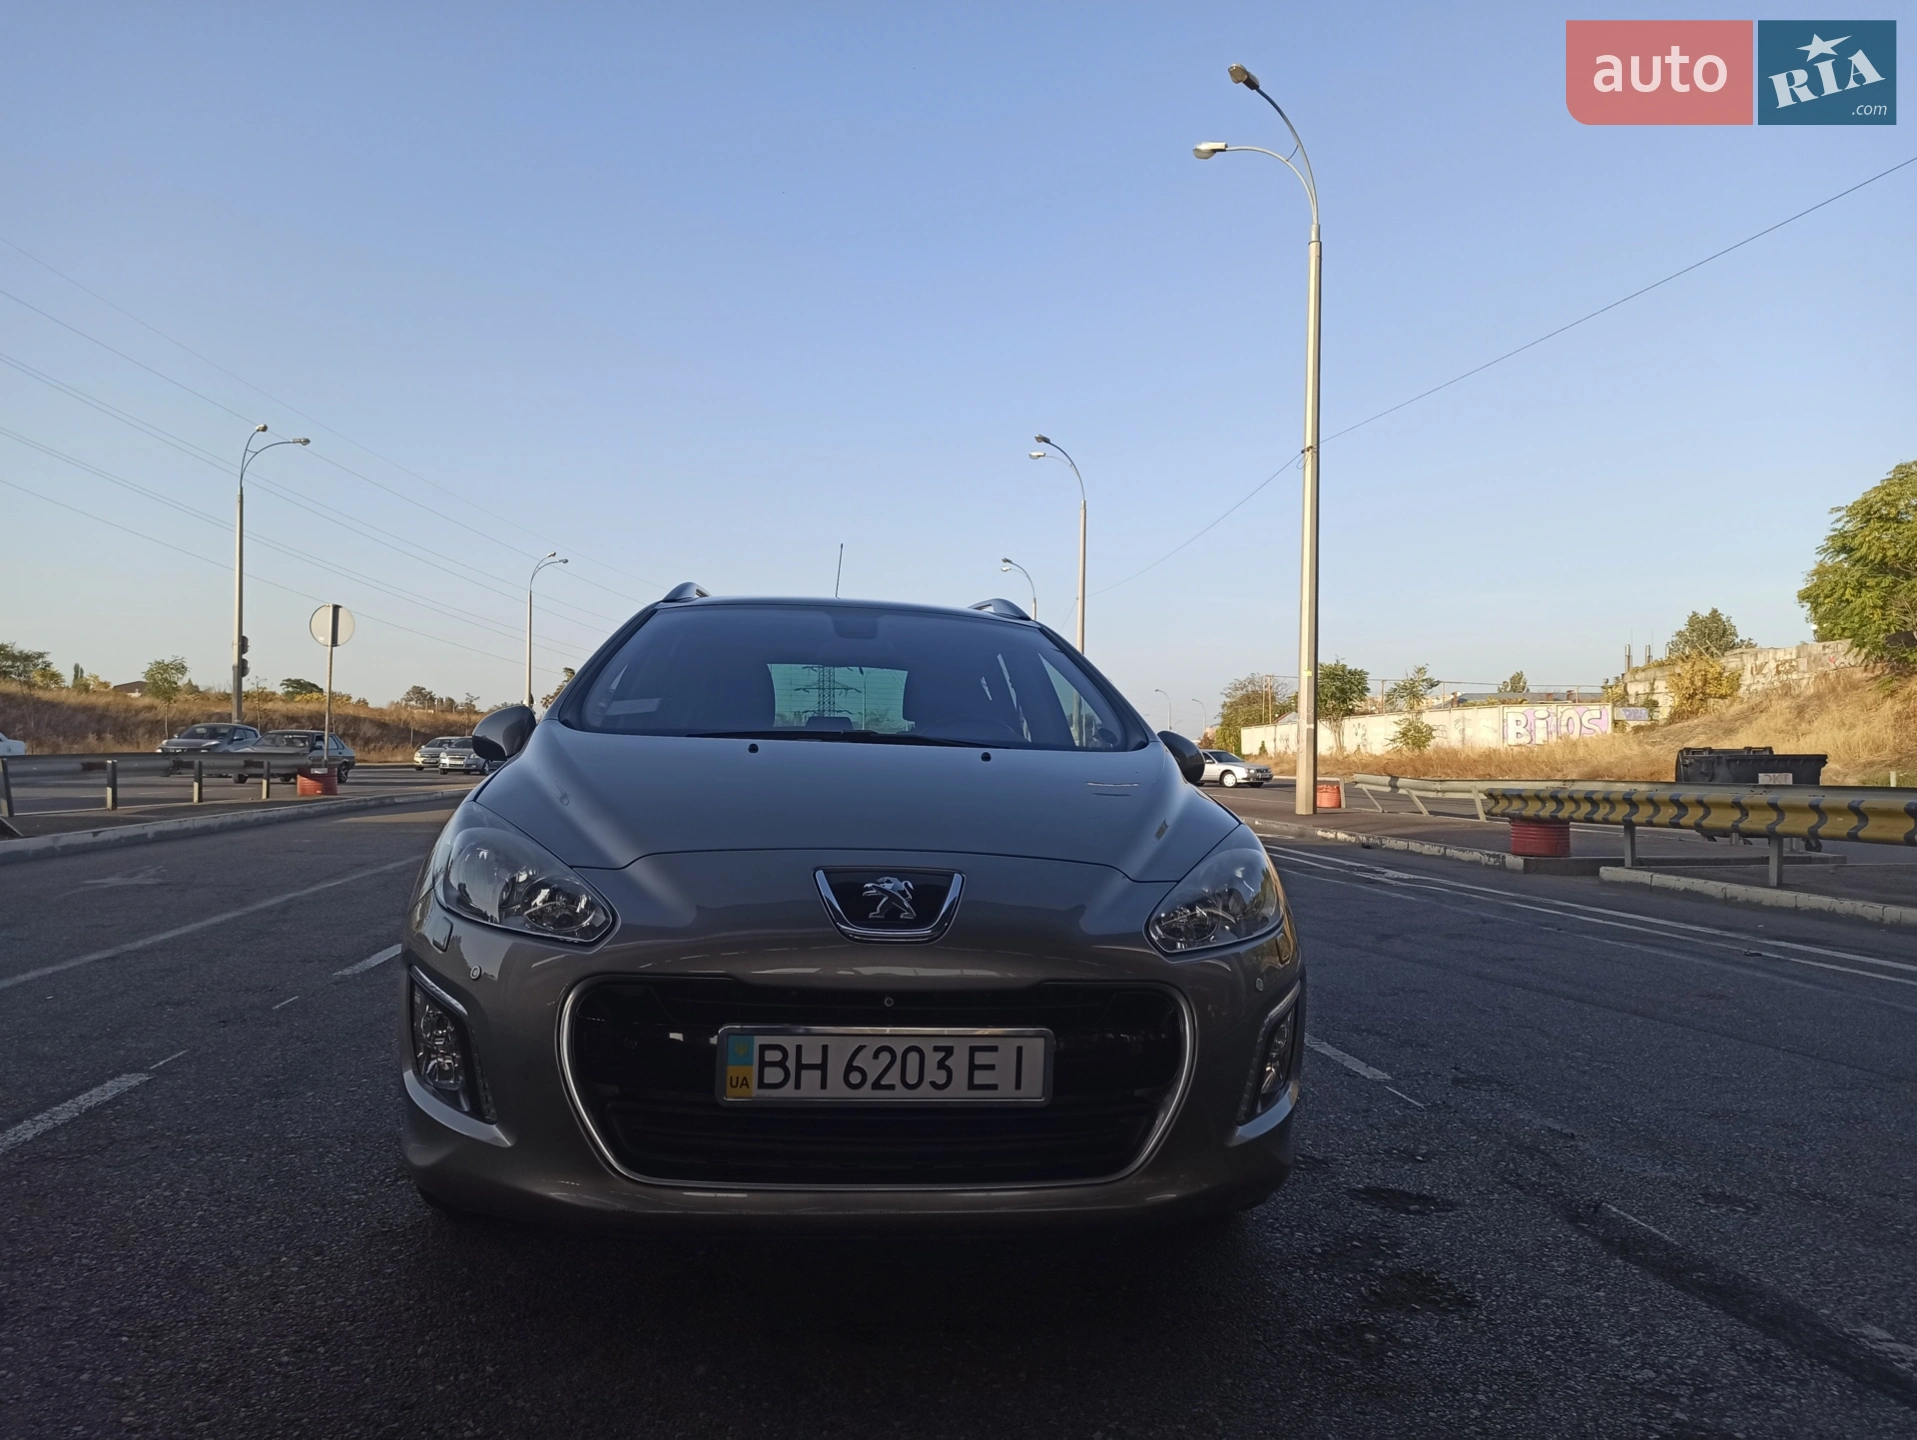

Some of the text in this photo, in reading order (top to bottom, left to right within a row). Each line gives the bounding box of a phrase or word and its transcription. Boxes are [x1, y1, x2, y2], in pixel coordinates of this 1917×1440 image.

[757, 1043, 1023, 1091] BH 6203 EI
[729, 1076, 750, 1089] UA
